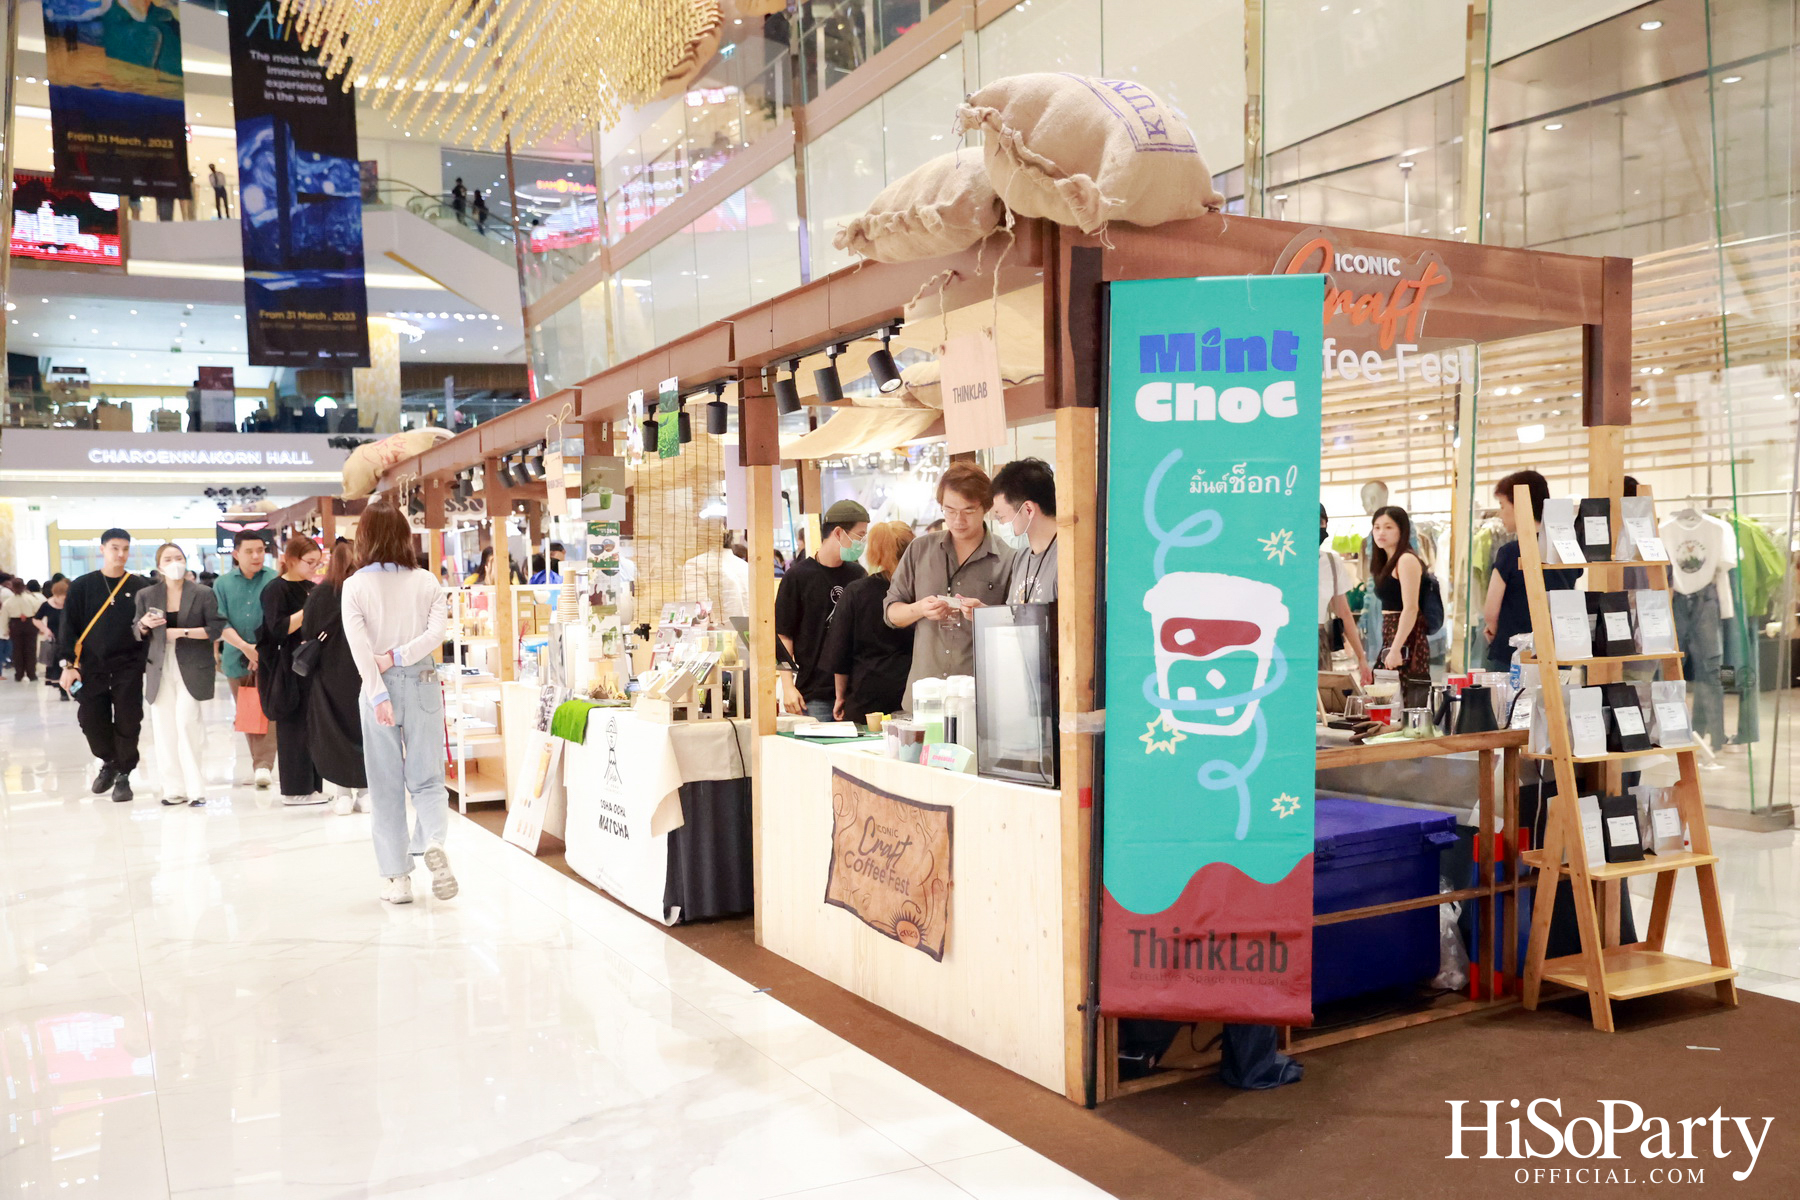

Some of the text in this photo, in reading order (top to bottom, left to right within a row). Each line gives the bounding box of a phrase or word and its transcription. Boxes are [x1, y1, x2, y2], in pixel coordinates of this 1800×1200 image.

[249, 49, 270, 62] The
[272, 54, 299, 65] most
[265, 79, 325, 93] experience
[276, 91, 295, 102] the
[297, 96, 327, 105] world
[67, 131, 95, 142] From
[1334, 252, 1401, 276] ICONIC
[259, 309, 285, 319] From
[287, 310, 296, 320] 31
[1140, 327, 1299, 374] Mint
[1396, 343, 1475, 384] Fest
[952, 381, 988, 404] THINKLAB
[88, 448, 314, 465] CHAROENNAKORN HALL
[598, 814, 630, 840] MATCHA
[858, 815, 913, 870] Craft
[844, 850, 910, 896] Coffee Fest
[1128, 926, 1289, 974] ThinkLab
[1187, 972, 1225, 985] Space
